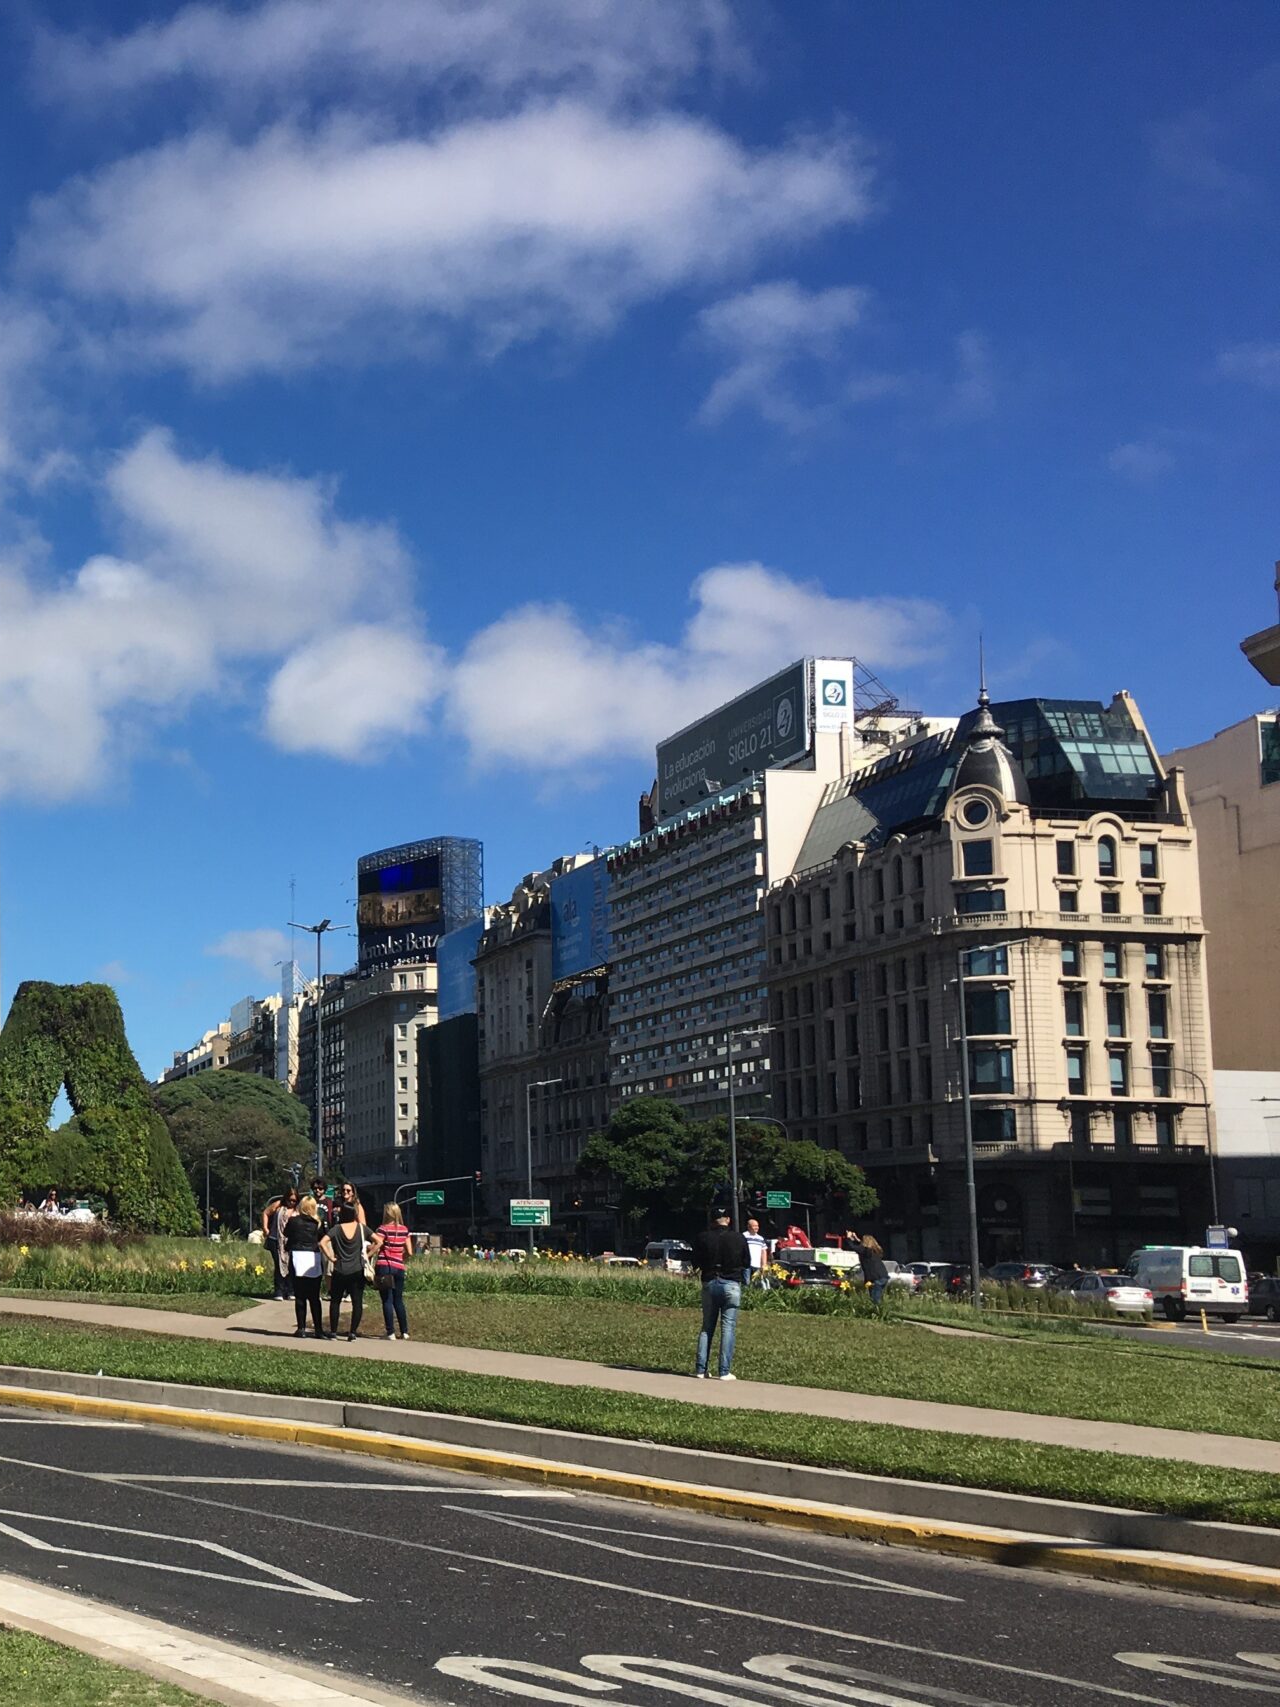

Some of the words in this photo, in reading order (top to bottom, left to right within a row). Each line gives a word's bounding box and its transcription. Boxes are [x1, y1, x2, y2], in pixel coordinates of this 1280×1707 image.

[727, 708, 772, 741] UNIVERSIDAD
[664, 764, 674, 780] La
[675, 739, 715, 773] educación
[728, 733, 757, 765] SIGLO
[760, 725, 773, 750] 21
[664, 768, 706, 801] evoluciona
